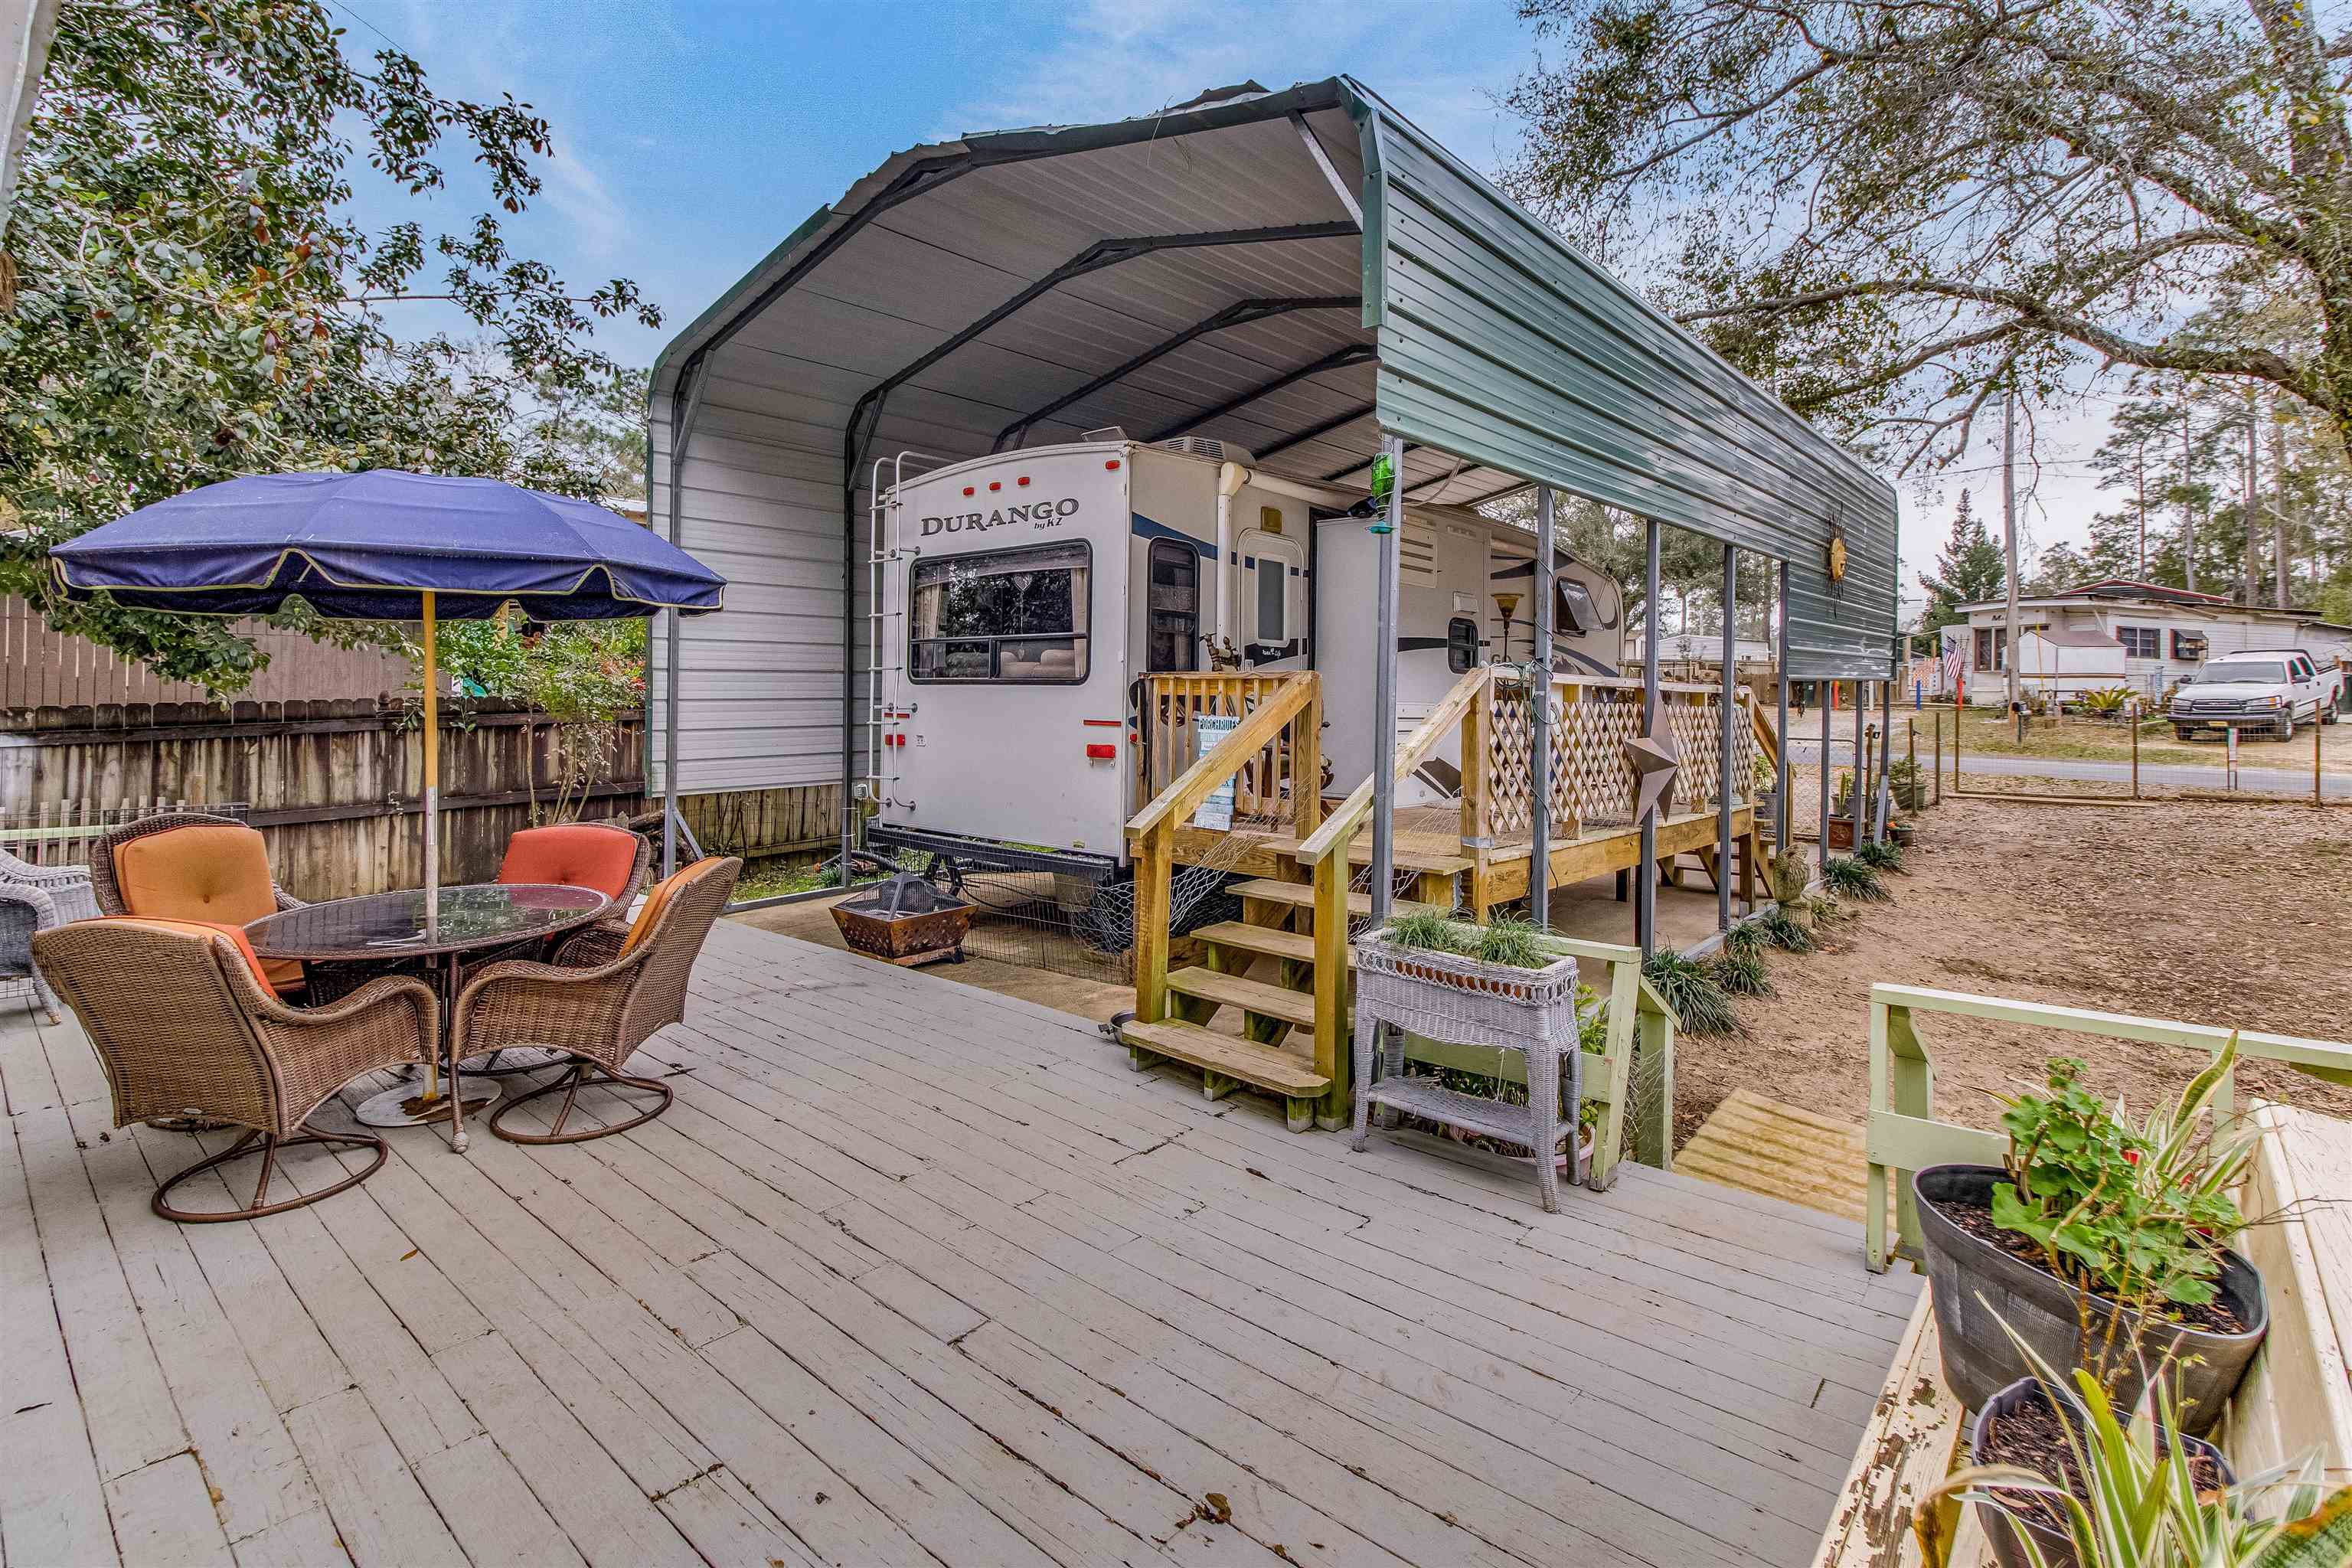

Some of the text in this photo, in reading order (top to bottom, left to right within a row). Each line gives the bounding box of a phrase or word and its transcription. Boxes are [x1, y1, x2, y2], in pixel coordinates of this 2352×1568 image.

[920, 498, 1080, 537] DURANGO
[1047, 517, 1063, 528] KZ
[1199, 718, 1220, 730] PORCH
